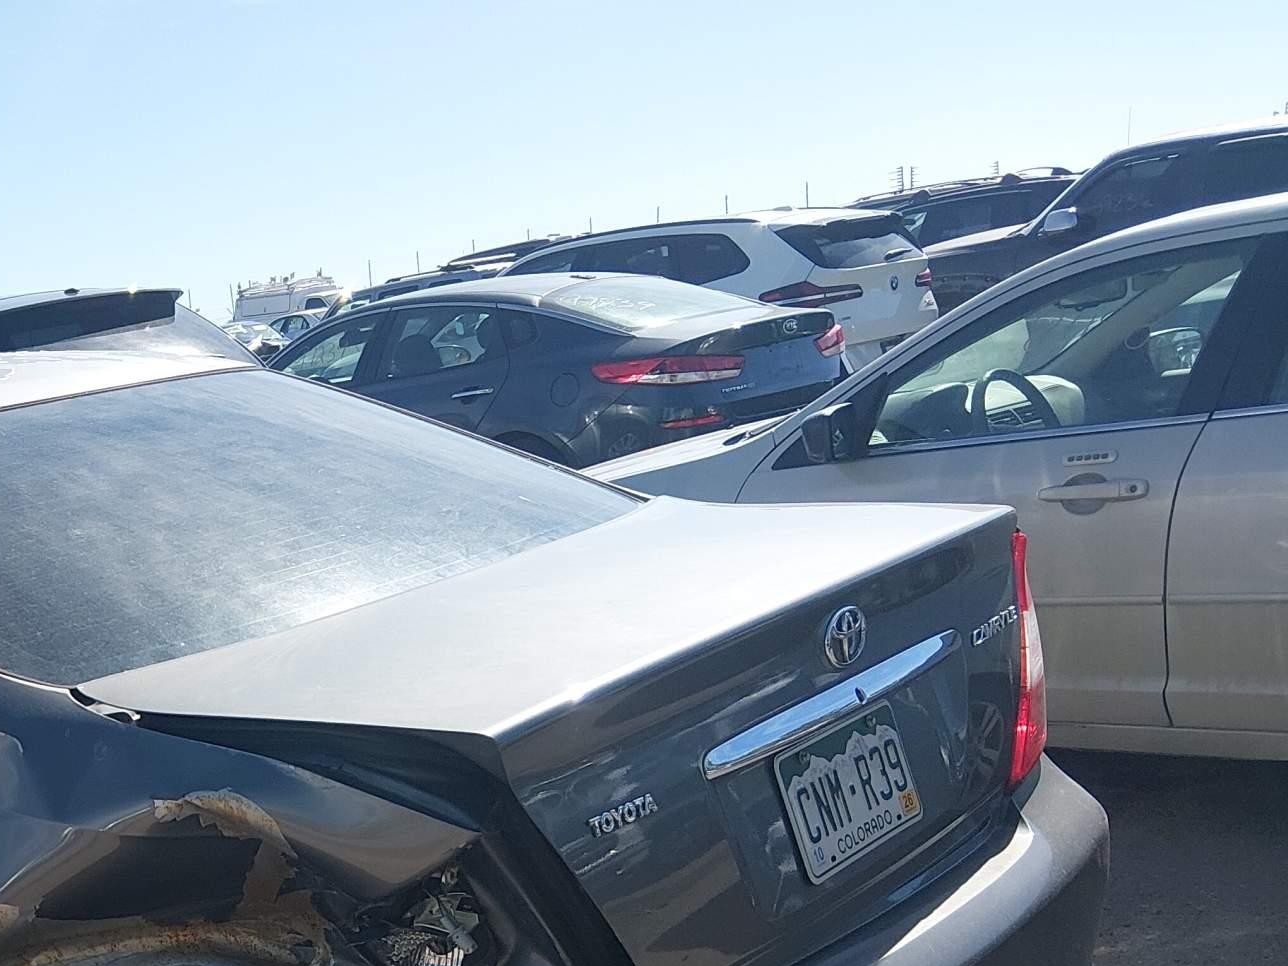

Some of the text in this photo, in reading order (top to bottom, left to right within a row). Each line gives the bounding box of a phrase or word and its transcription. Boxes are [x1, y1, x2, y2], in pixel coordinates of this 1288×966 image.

[588, 793, 659, 838] TOYOTA
[902, 793, 915, 809] 26
[837, 809, 893, 854] COLORADO
[813, 847, 825, 863] 10
